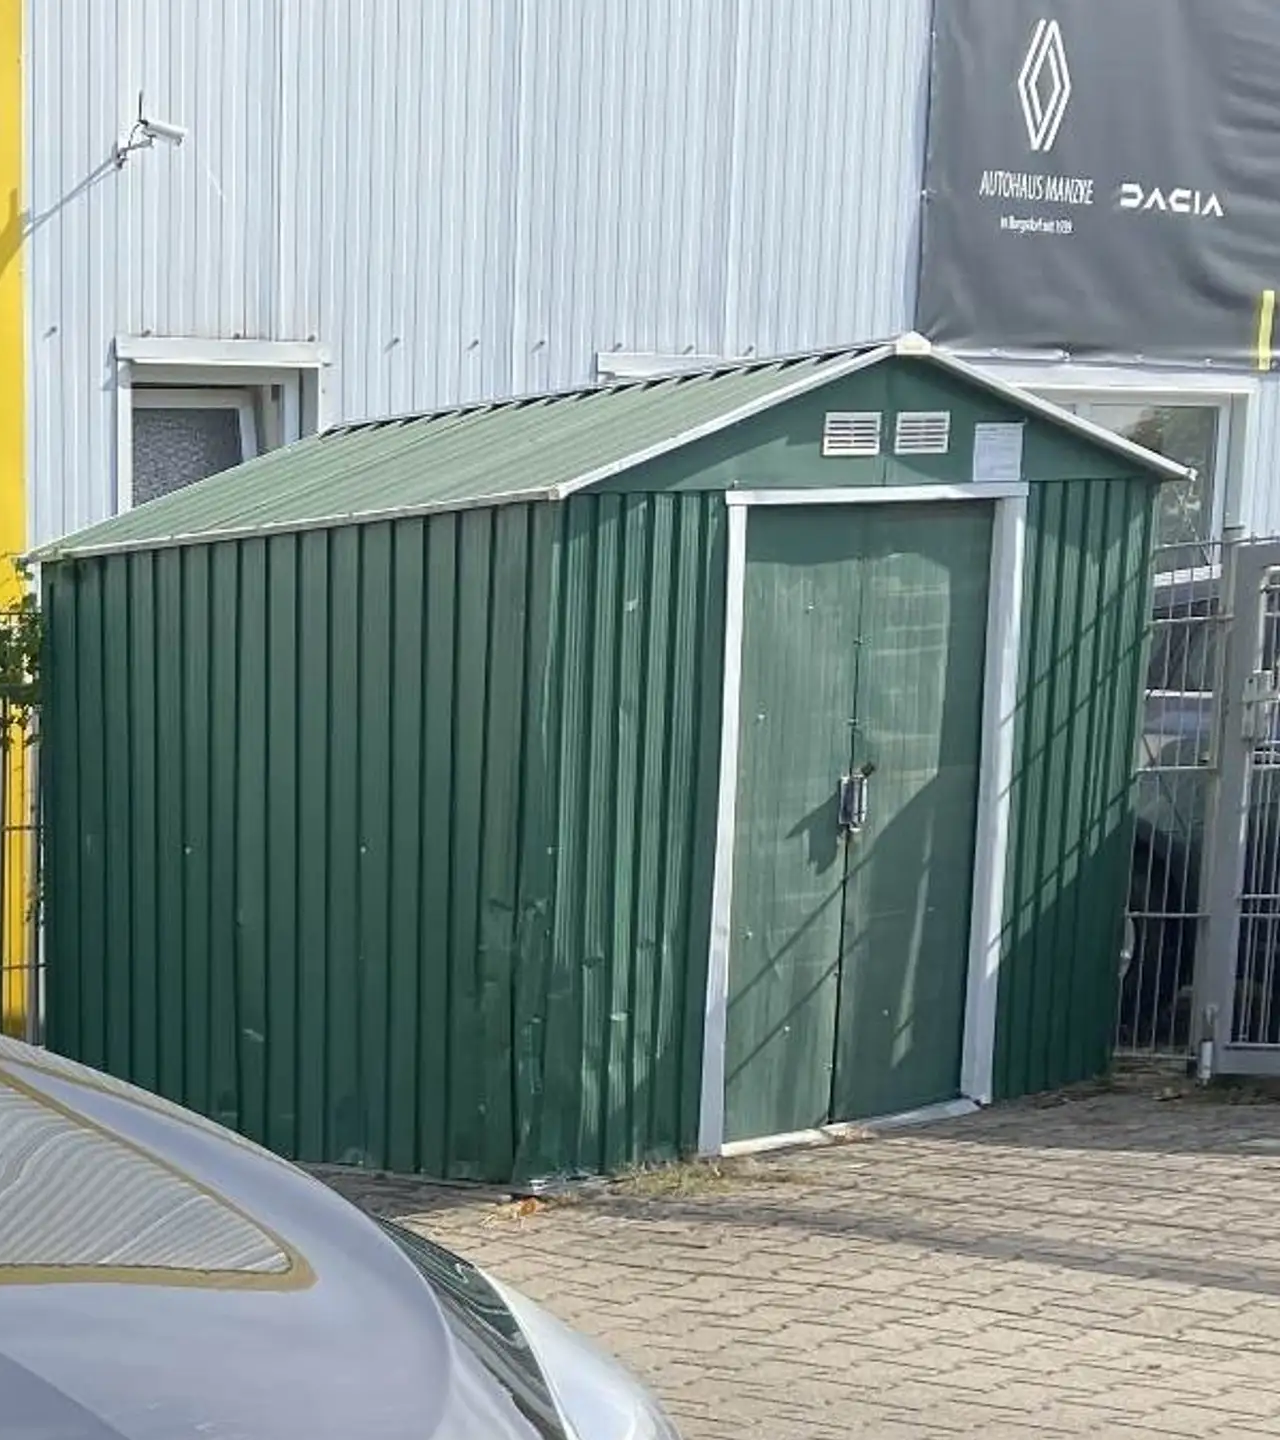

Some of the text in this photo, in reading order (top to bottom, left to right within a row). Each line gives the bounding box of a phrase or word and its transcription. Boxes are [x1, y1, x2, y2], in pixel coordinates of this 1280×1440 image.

[979, 170, 1094, 204] AUTOHAUS MANZKE
[1120, 183, 1224, 217] DACIA
